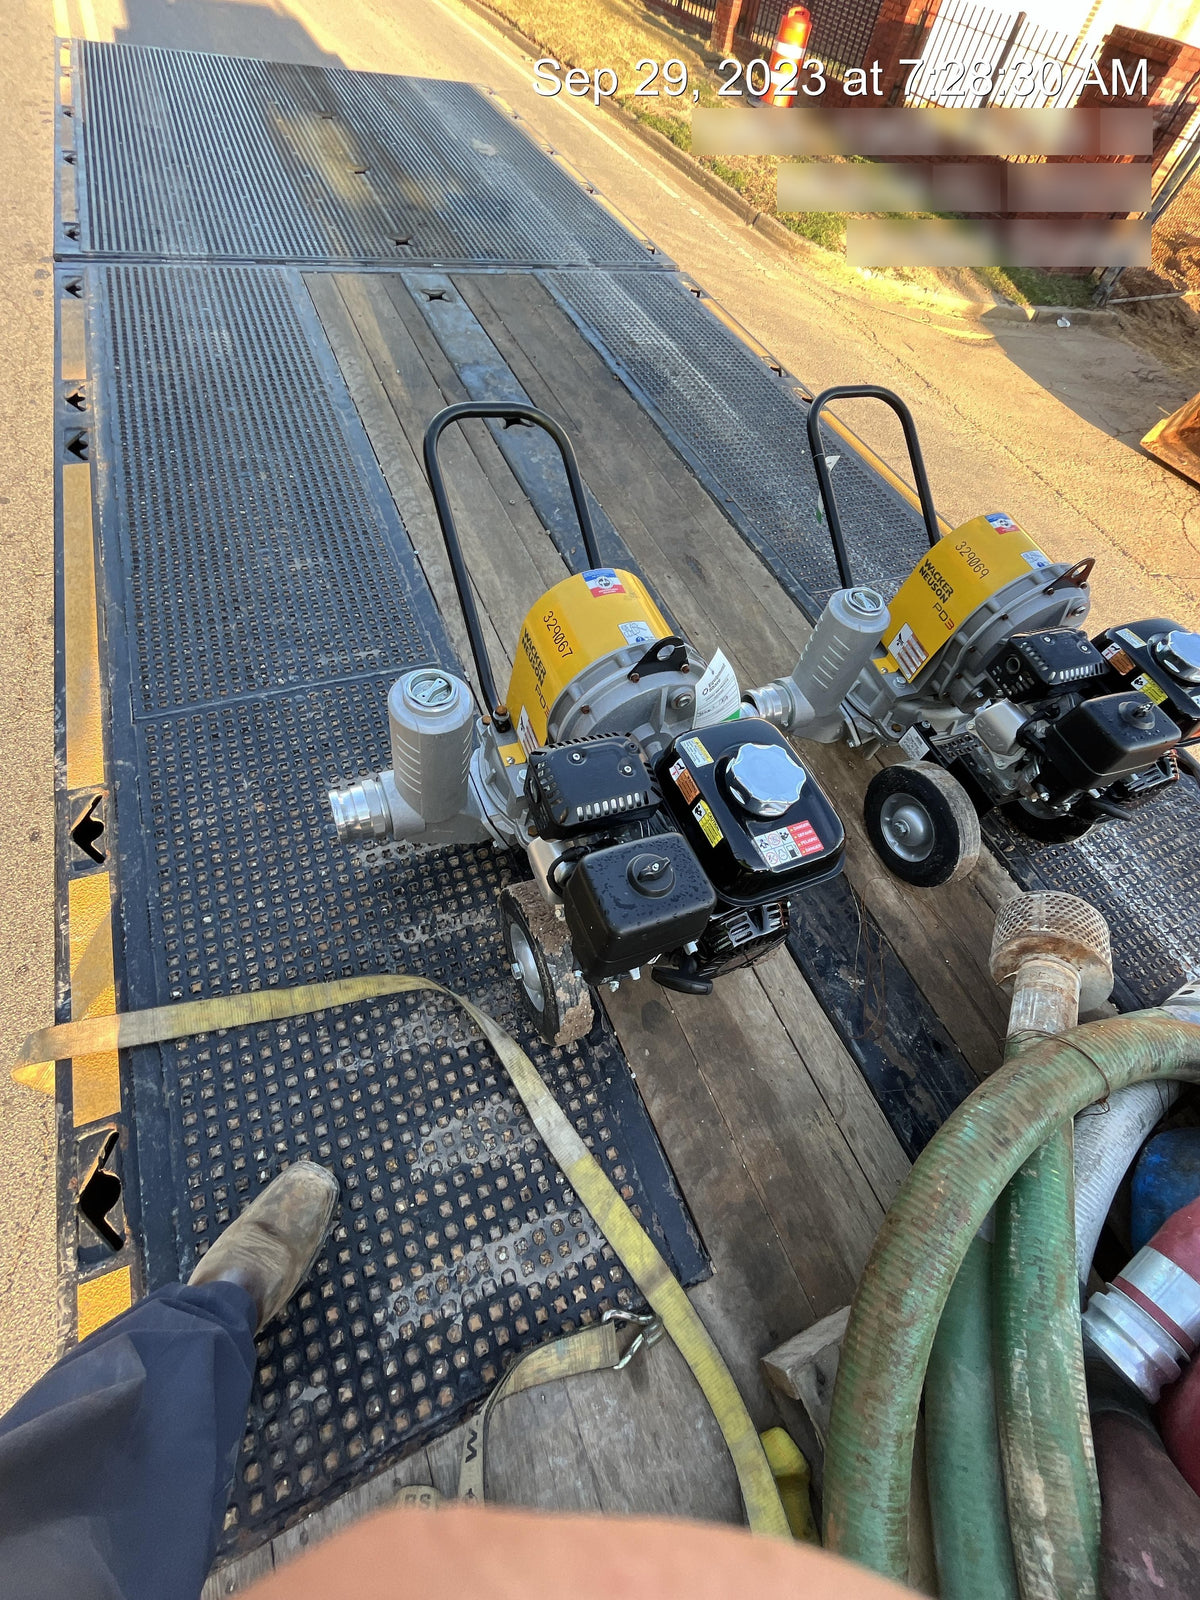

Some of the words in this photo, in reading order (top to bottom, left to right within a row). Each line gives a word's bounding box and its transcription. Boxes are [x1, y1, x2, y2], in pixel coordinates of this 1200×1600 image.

[924, 558, 954, 598] WACKER
[955, 541, 990, 580] 329069
[918, 566, 949, 604] NEUSON
[543, 610, 573, 658] 329067
[932, 602, 955, 631] PD3
